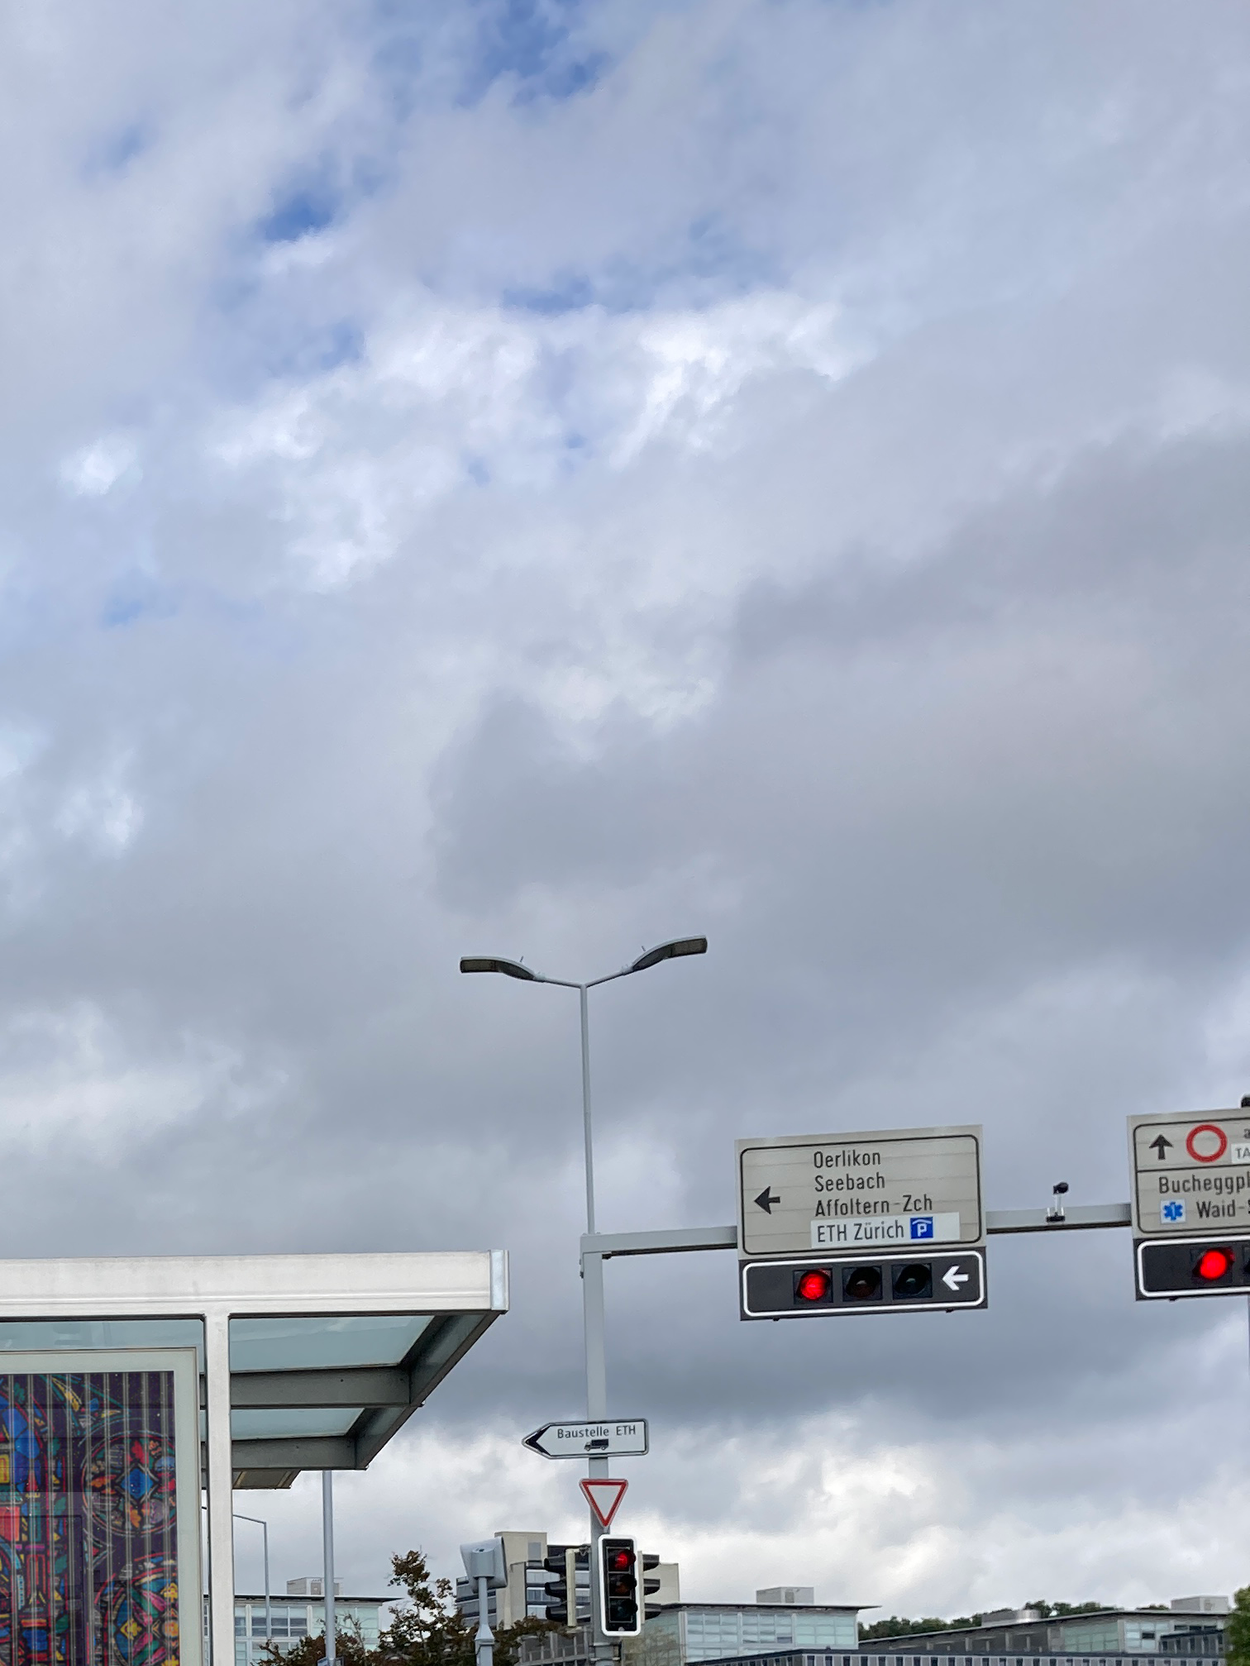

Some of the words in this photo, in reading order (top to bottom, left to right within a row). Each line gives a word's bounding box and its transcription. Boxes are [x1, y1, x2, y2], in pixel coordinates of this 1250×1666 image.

[813, 1150, 881, 1168] Oerlikon
[814, 1172, 885, 1192] Seebach
[817, 1224, 847, 1243] ETH
[854, 1220, 904, 1240] Zürich
[557, 1426, 609, 1439] Baustelle
[616, 1425, 636, 1436] ETH
